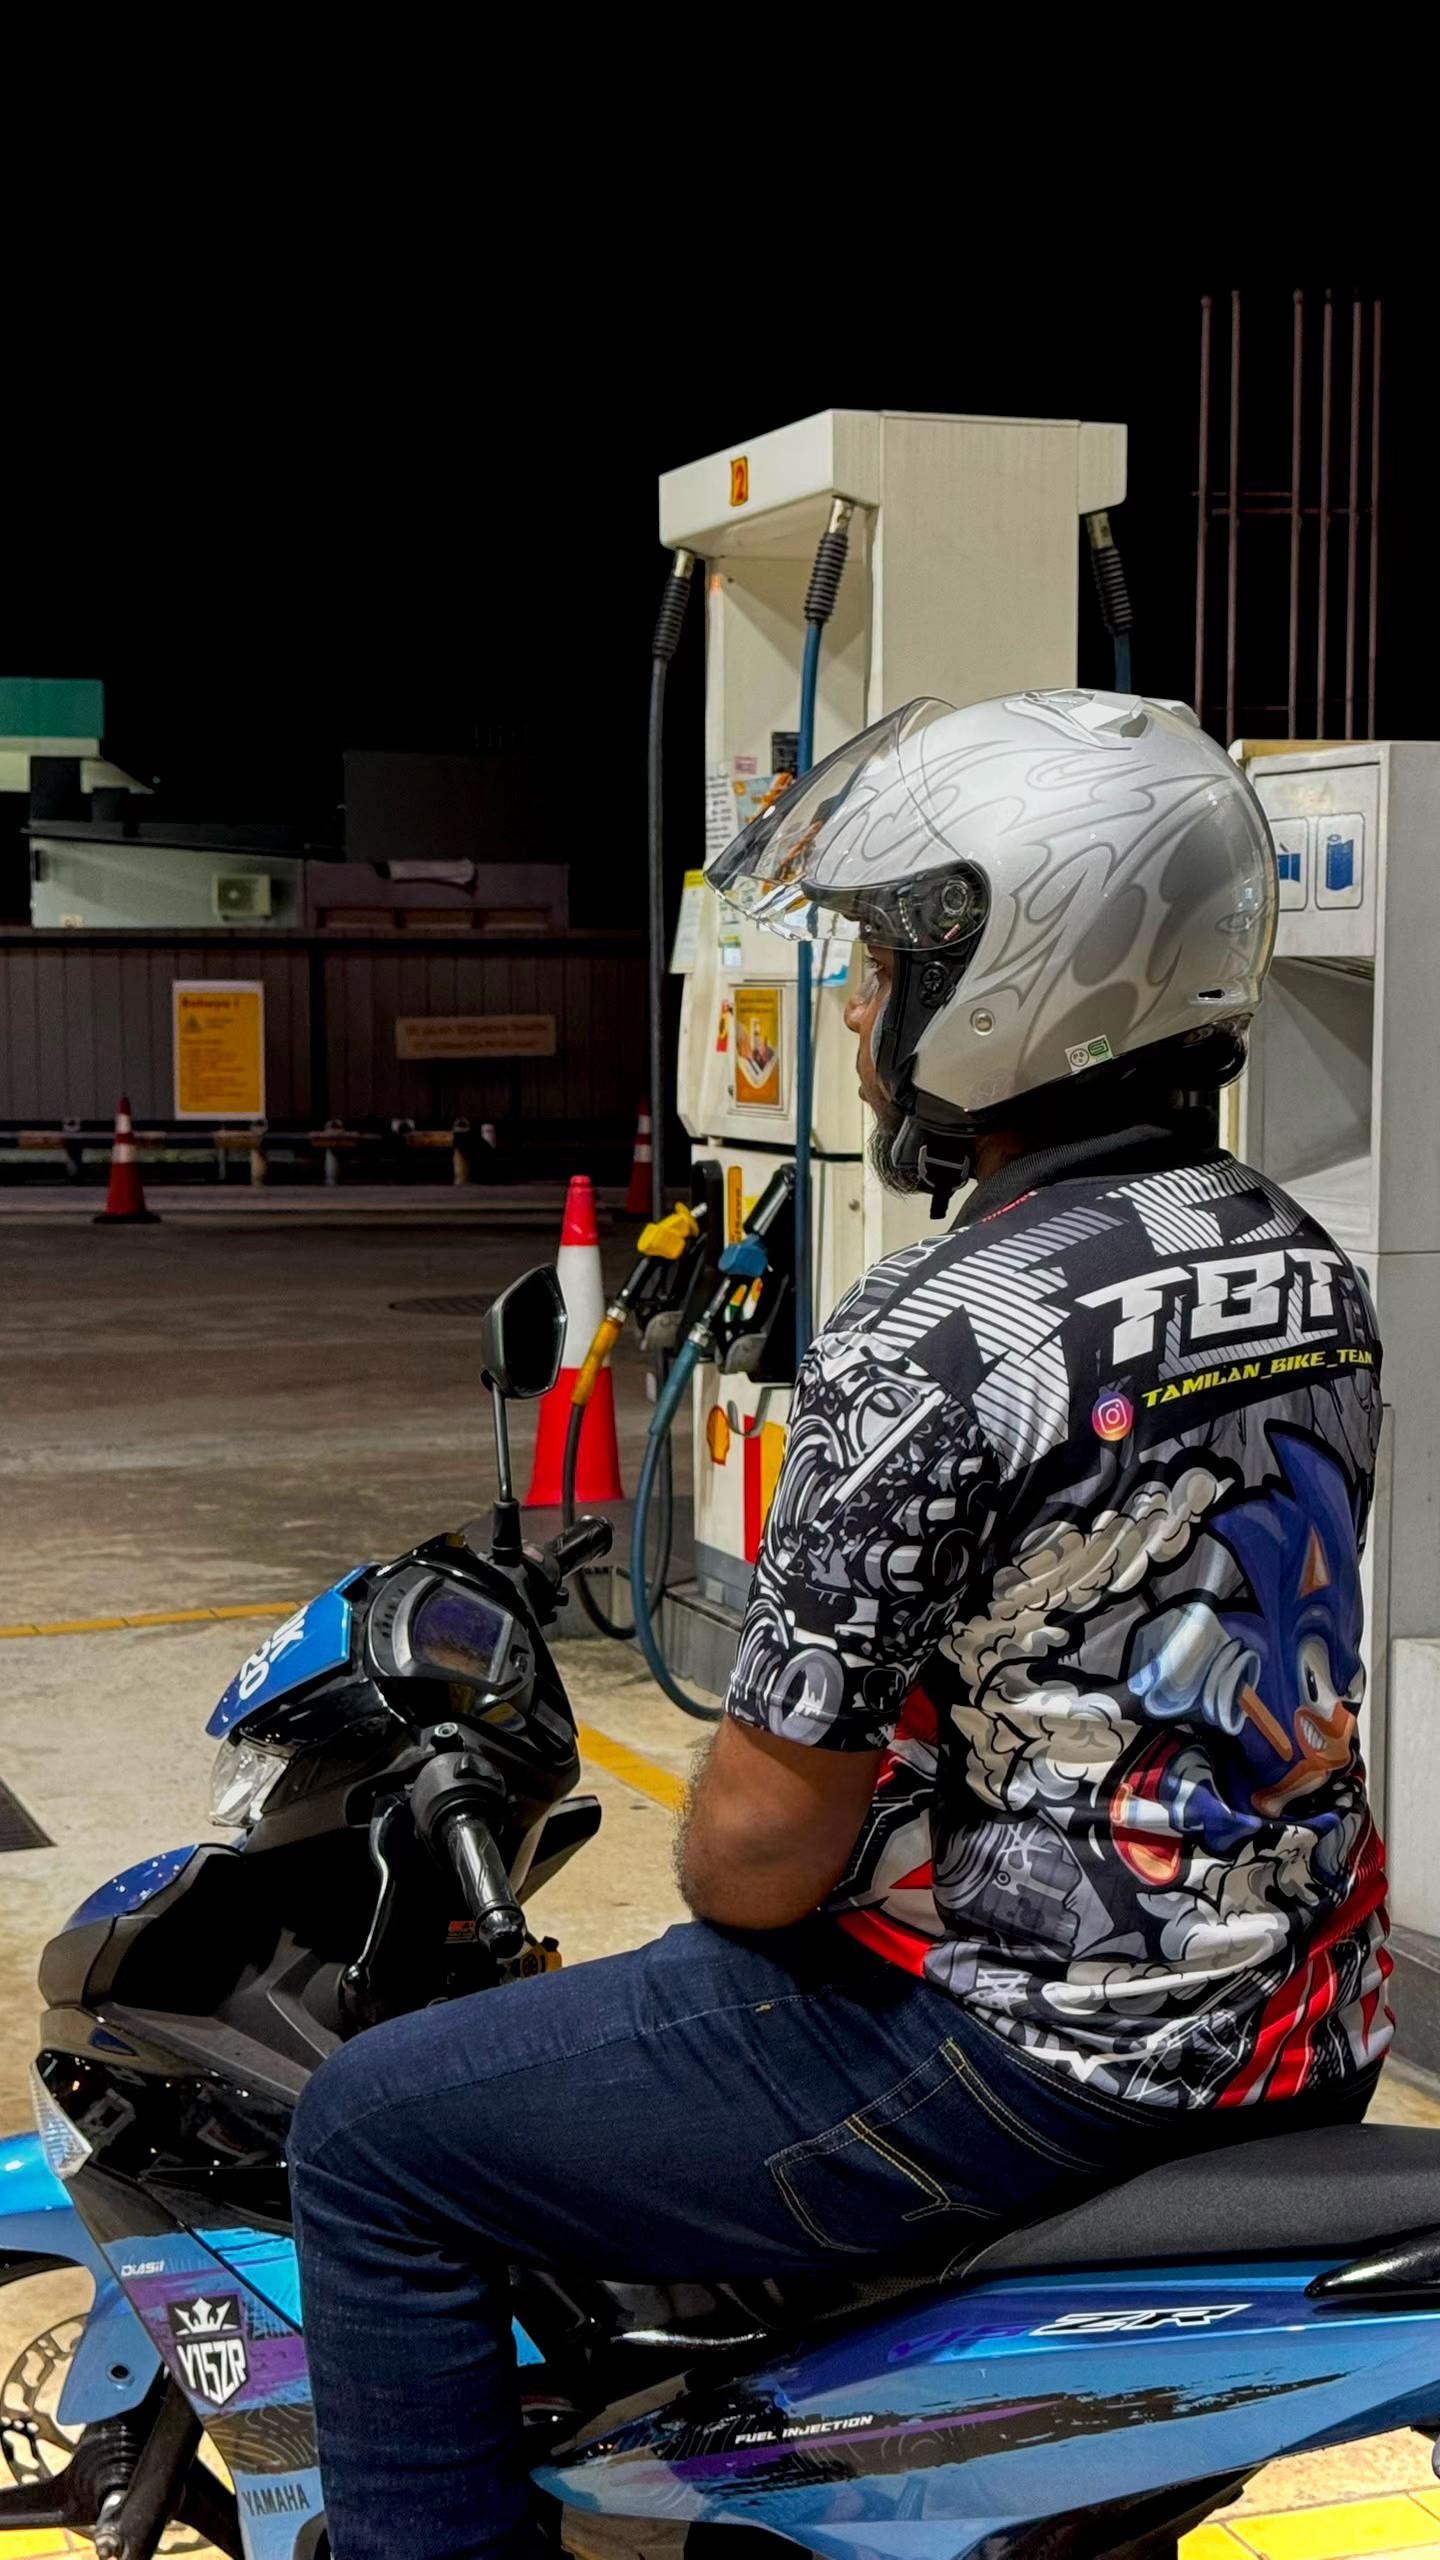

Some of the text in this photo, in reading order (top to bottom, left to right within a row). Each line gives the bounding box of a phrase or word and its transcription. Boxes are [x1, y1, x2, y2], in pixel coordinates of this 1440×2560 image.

[735, 464, 745, 501] 2
[1075, 1248, 1345, 1365] TBT
[176, 2338, 247, 2405] Y15ZR
[734, 2414, 874, 2444] FUEL INJECTION
[241, 2483, 310, 2517] YAMAHA
